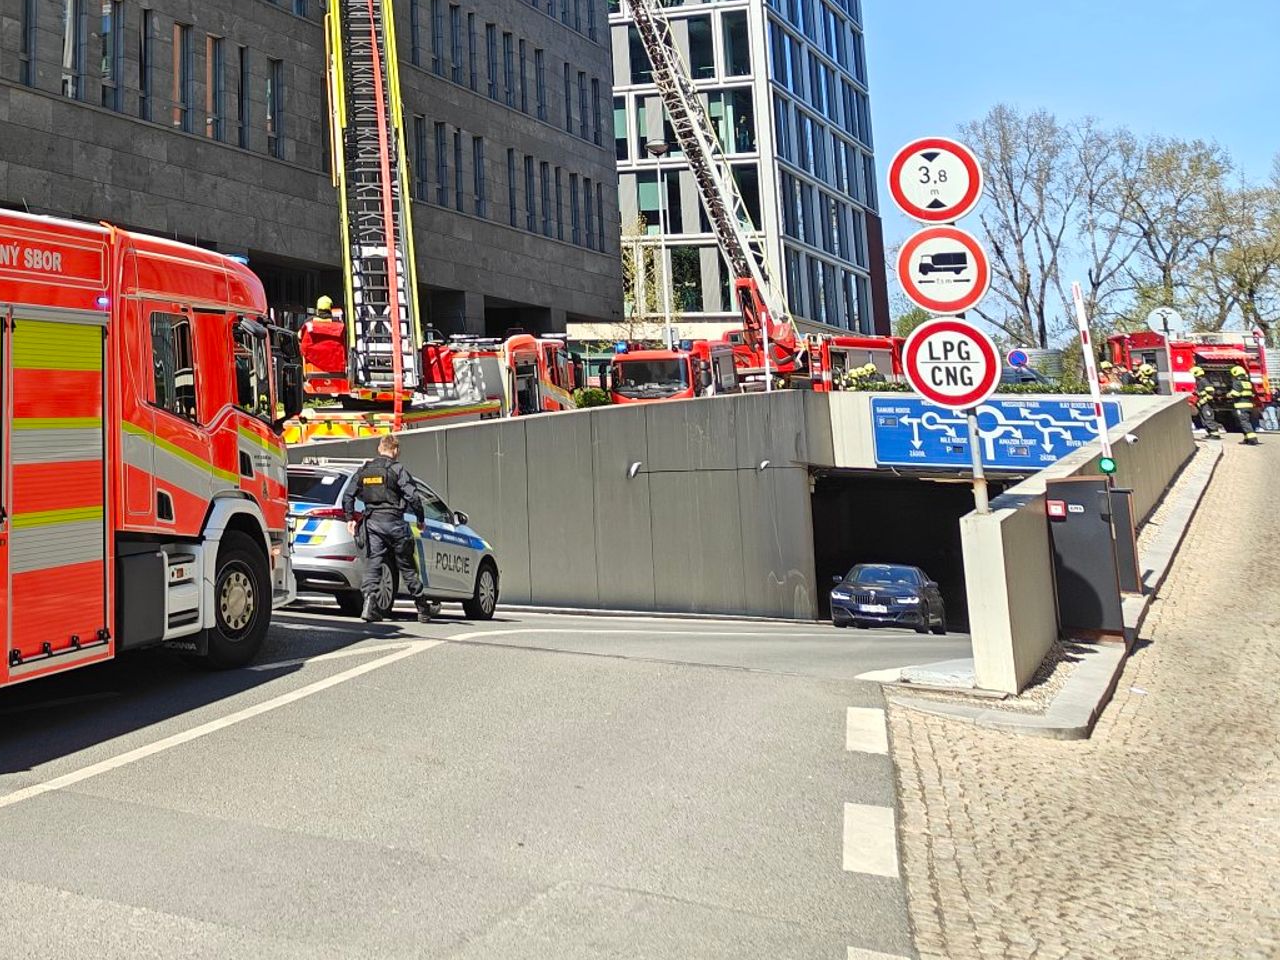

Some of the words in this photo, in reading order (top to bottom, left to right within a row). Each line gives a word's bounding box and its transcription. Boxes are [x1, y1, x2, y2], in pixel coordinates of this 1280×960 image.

[24, 247, 63, 272] SBOR
[928, 340, 971, 361] LPG
[931, 365, 974, 386] CNG
[435, 552, 470, 574] POLICIE
